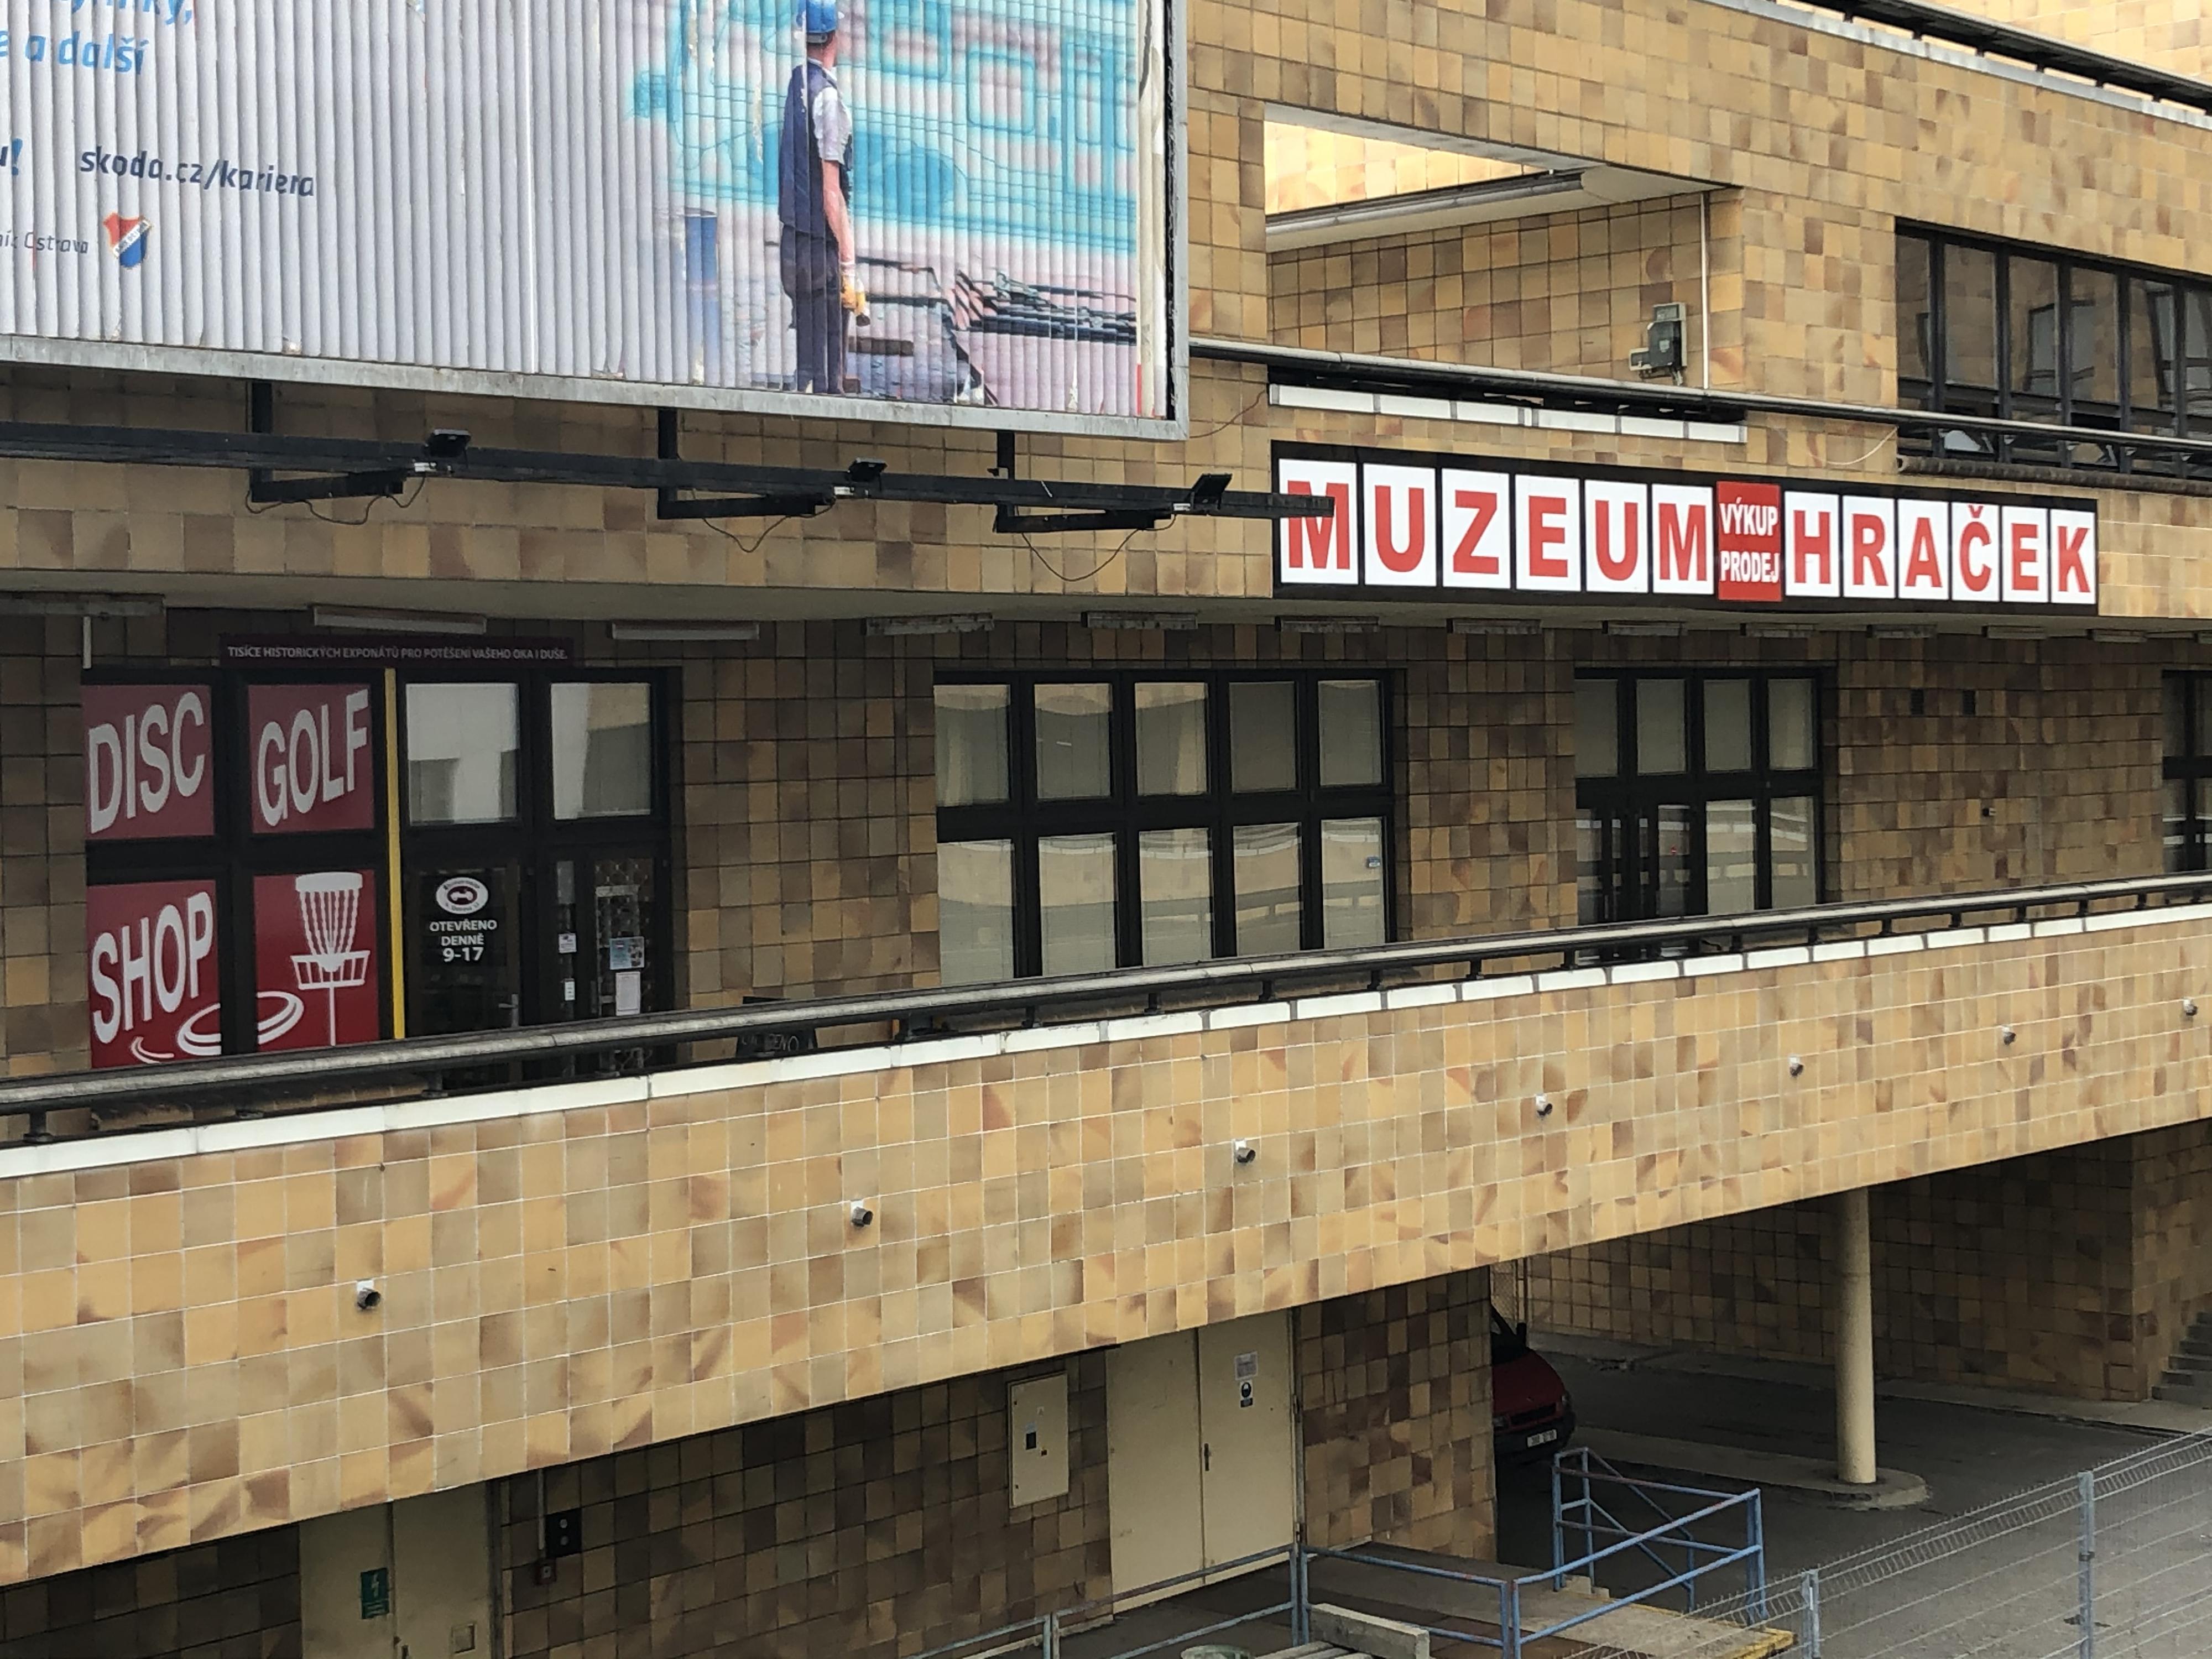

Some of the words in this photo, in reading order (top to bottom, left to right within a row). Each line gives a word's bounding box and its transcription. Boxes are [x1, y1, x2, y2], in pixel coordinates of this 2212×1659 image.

[25, 35, 46, 62] a
[59, 30, 149, 75] další
[80, 145, 315, 197] skoda.cz/kariera
[1287, 479, 1708, 582] MUZEUM
[1793, 504, 2091, 593] HRAČEK
[1719, 496, 1778, 536] VÝKUP
[1720, 550, 1781, 583] PRODEJ
[227, 644, 262, 658] TISÍCE
[264, 646, 341, 658] HISTORICKÝCH
[401, 648, 421, 659] PRO
[472, 646, 512, 659] VAŠEHO
[513, 649, 534, 659] OKA
[88, 691, 205, 834] DISC
[257, 688, 369, 827] GOLF
[429, 918, 498, 932] OTEVŘENO
[441, 932, 485, 947] DENNĚ
[91, 891, 214, 1045] SHOP
[442, 946, 484, 963] 9-17
